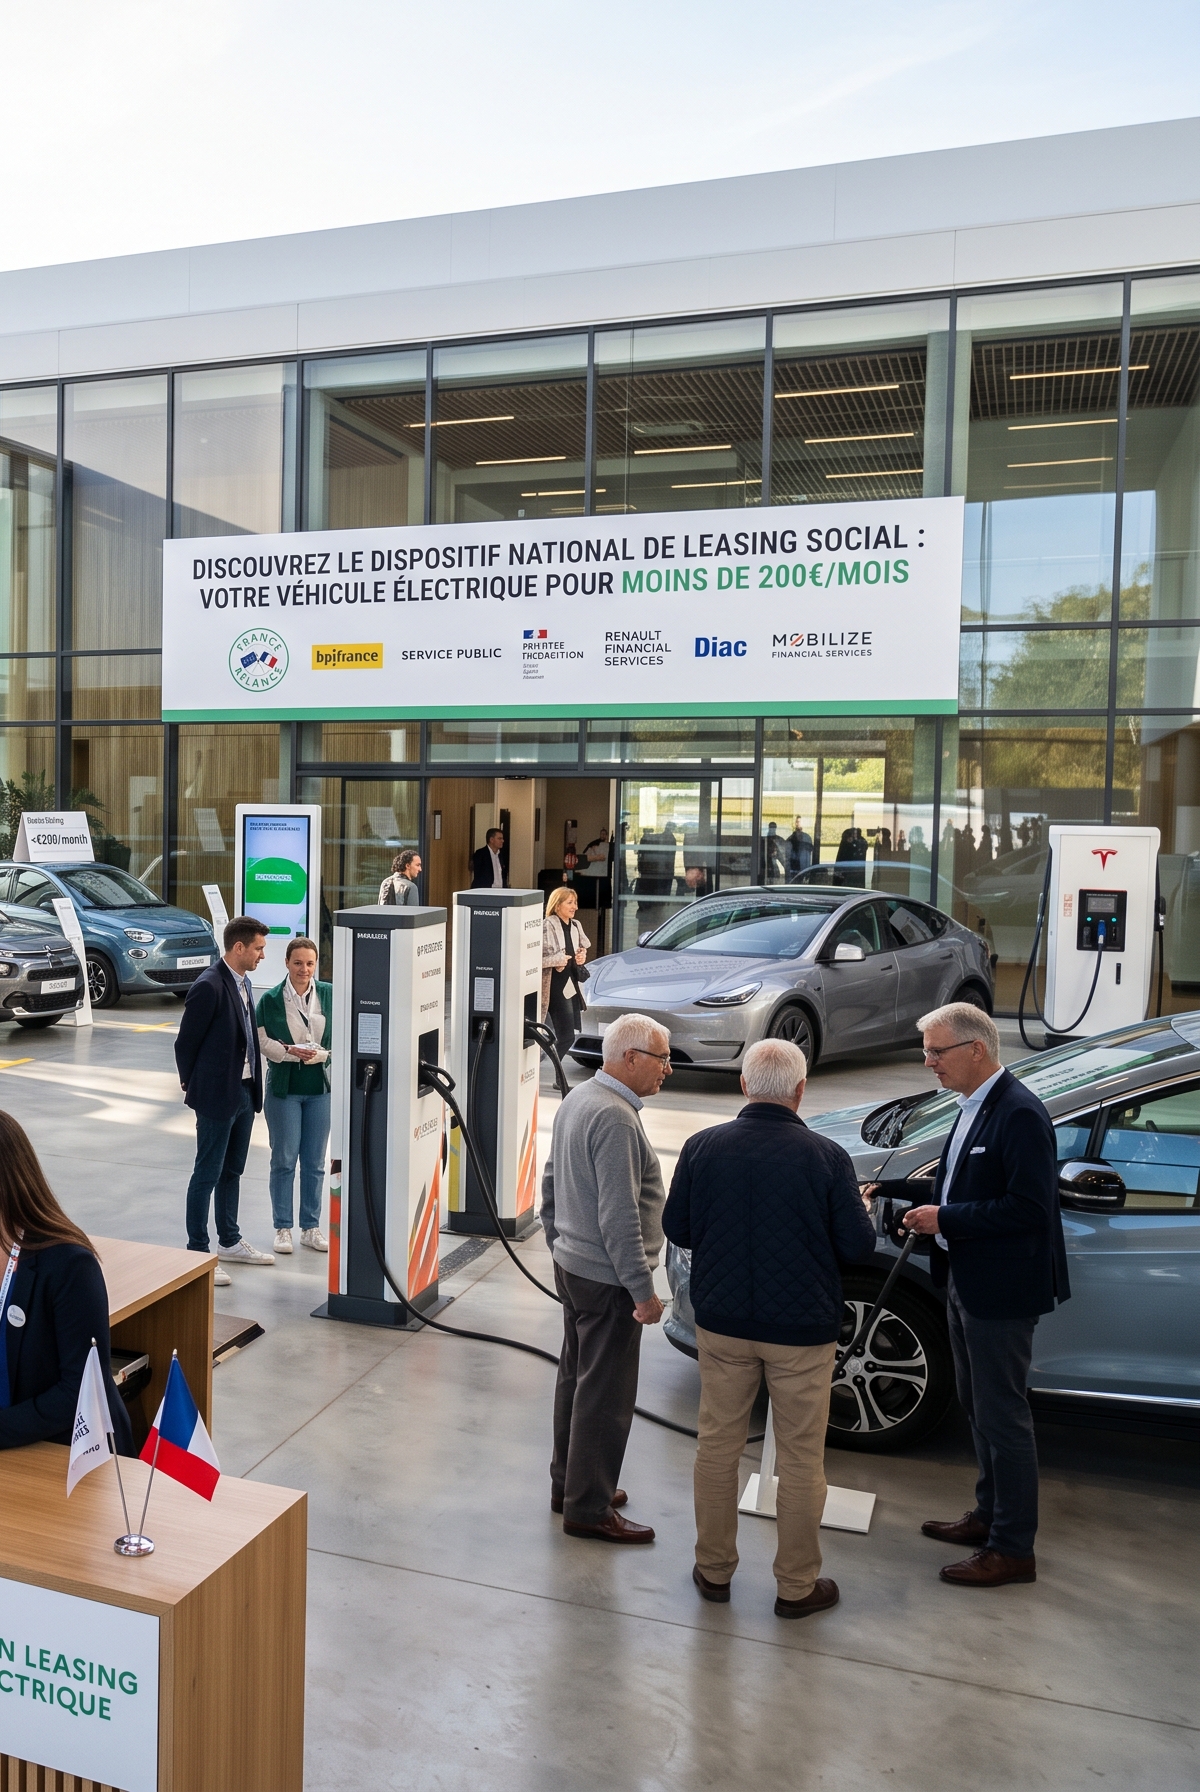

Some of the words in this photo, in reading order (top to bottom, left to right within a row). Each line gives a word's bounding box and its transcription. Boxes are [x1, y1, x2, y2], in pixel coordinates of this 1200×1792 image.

[193, 552, 331, 580] DISCOUVREZ
[337, 551, 364, 574] LE
[371, 544, 501, 572] DISPOSITIF
[508, 537, 635, 566] NATIONAL
[643, 535, 676, 560] DE
[683, 530, 798, 559] LEASING
[806, 524, 908, 553] SOCIAL
[200, 586, 270, 609] VOTRE
[276, 580, 386, 607] VÉHICULE
[393, 574, 538, 602] ÉLECTRIQUE
[546, 572, 614, 597] POUR
[622, 567, 708, 594] MOINS
[717, 566, 750, 591] DE
[758, 559, 910, 589] 200€/MOIS
[236, 632, 282, 652] FRANCE
[605, 630, 661, 642] RENAULT
[772, 631, 873, 647] MOBILIZE
[401, 650, 453, 660] SERVICE
[456, 648, 502, 659] PUBLIC
[605, 643, 671, 654] FINANCIAL
[694, 636, 747, 658] Diac
[772, 650, 823, 659] FINANCIAL
[825, 649, 873, 658] SERVICES
[316, 649, 379, 666] bpifrance
[604, 656, 664, 666] SERVICES
[31, 833, 88, 845] <€200/month
[25, 1644, 138, 1695] LEASING
